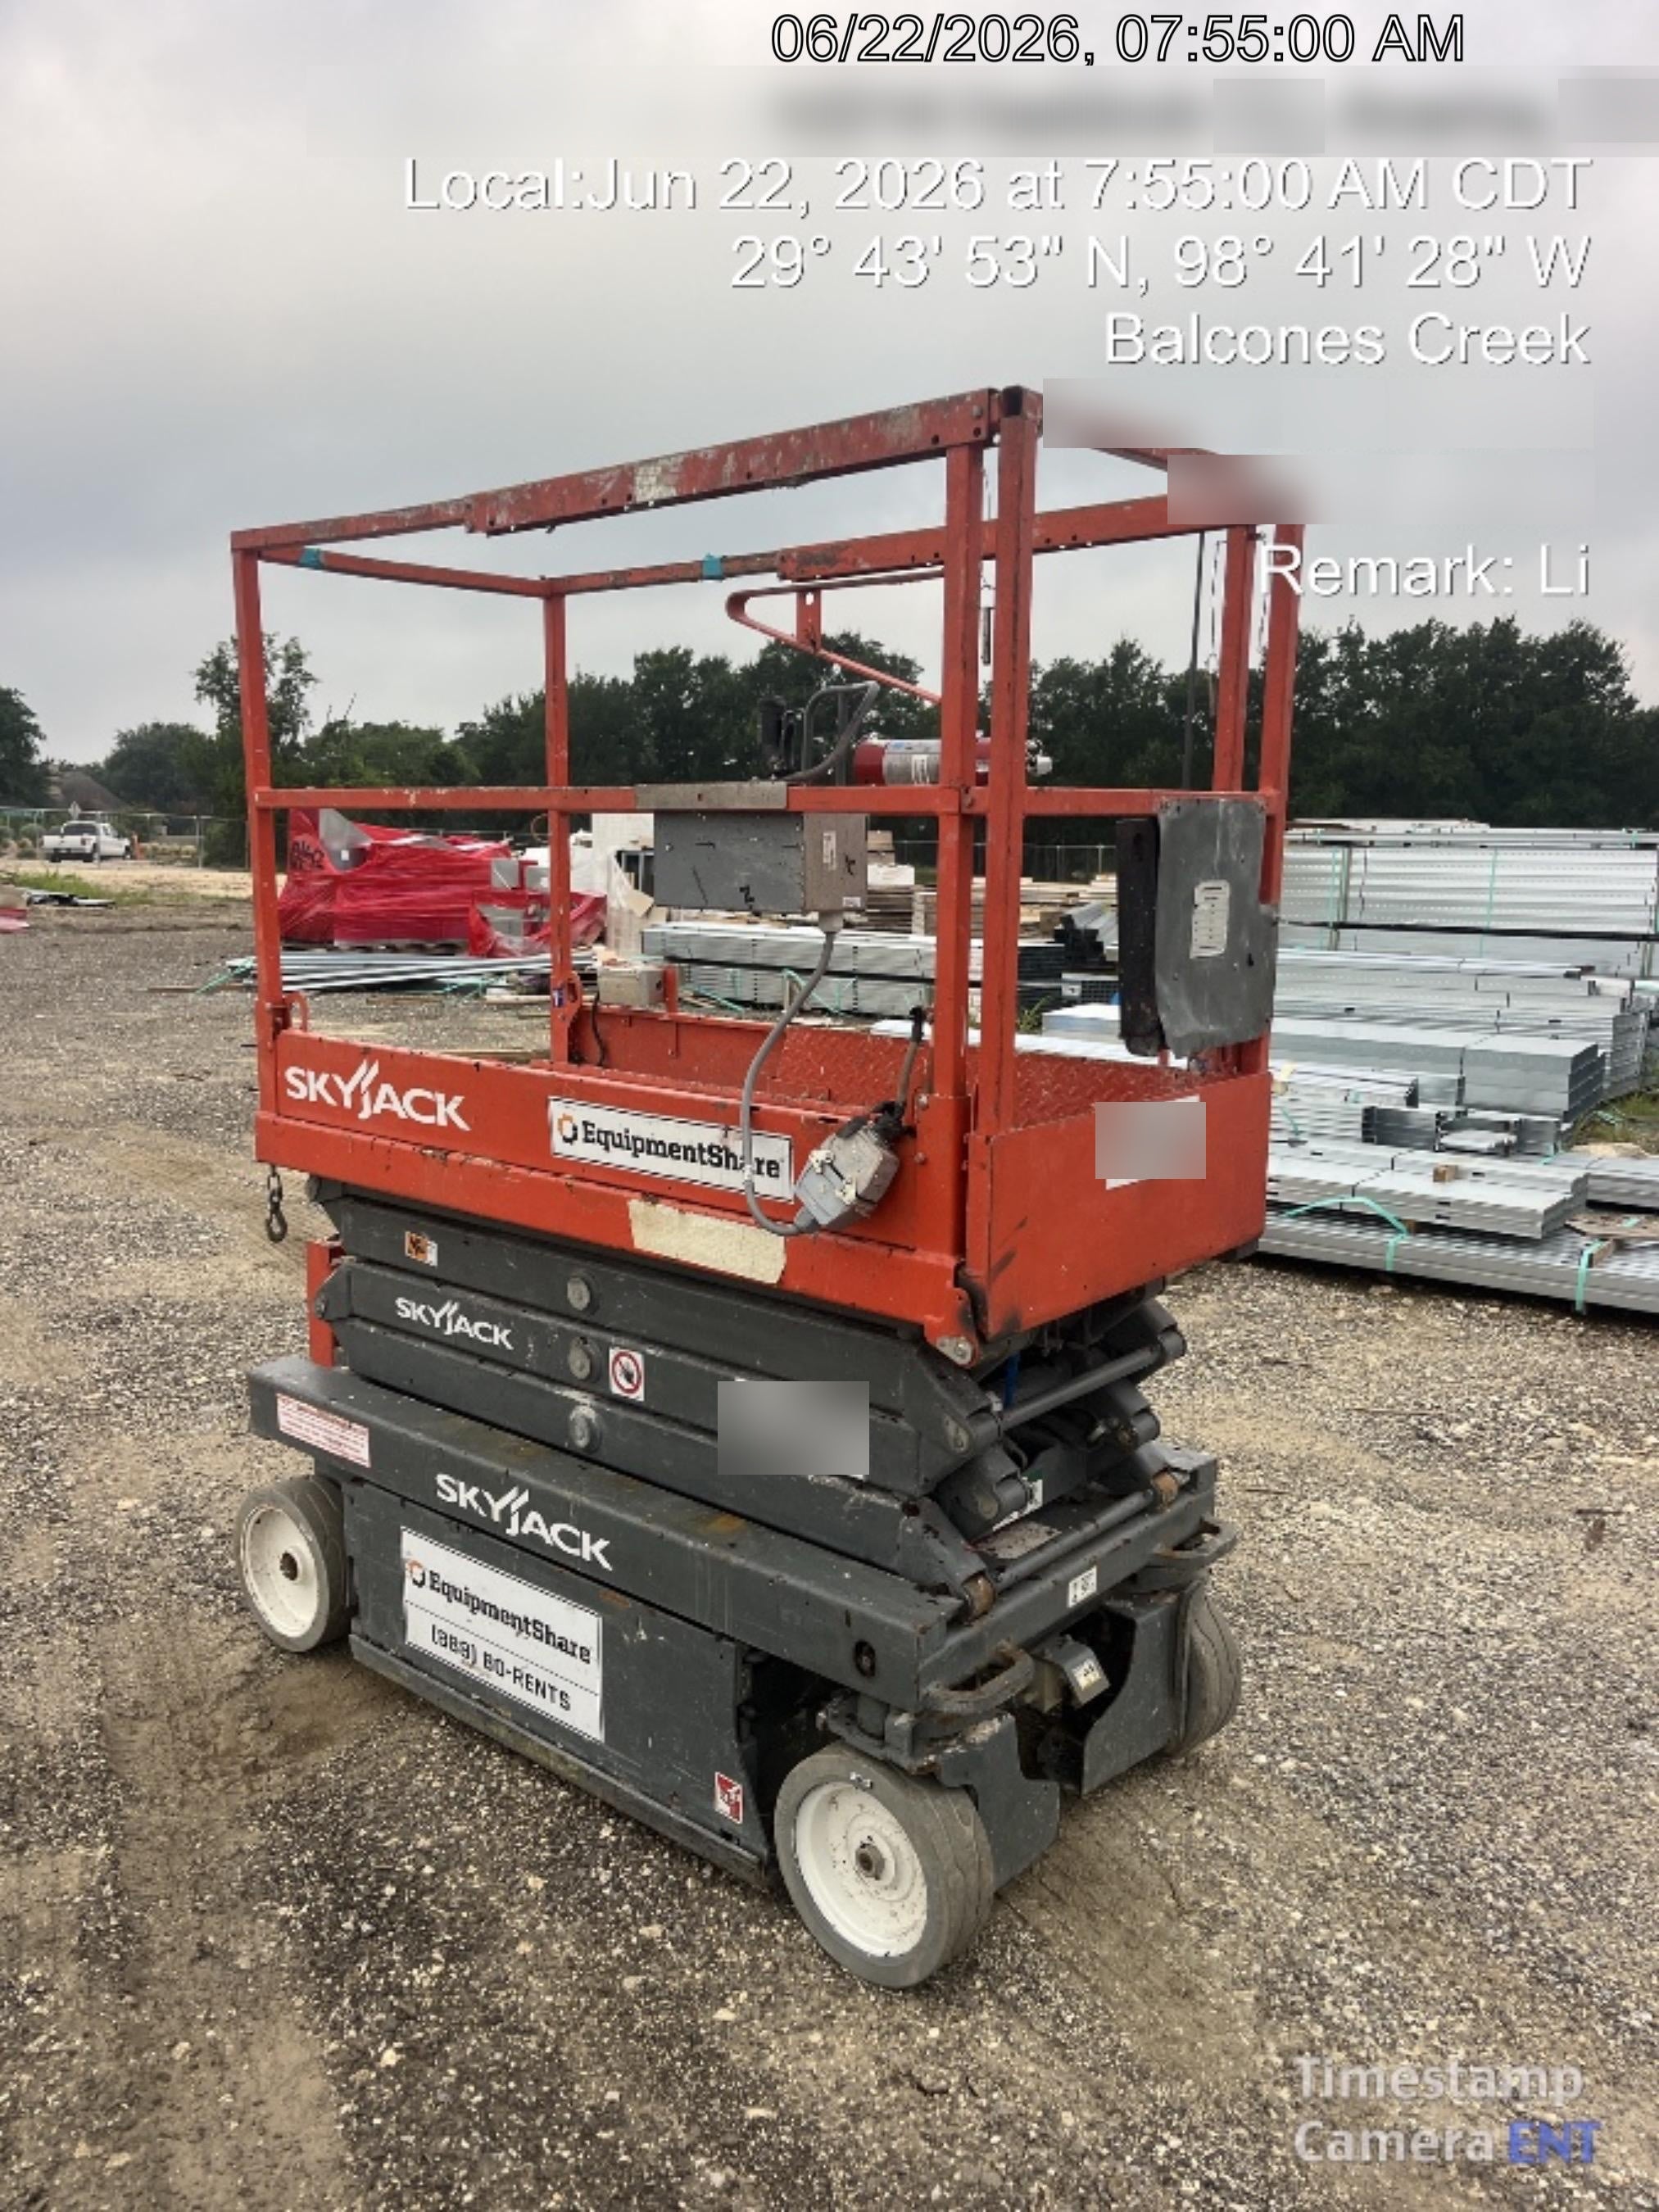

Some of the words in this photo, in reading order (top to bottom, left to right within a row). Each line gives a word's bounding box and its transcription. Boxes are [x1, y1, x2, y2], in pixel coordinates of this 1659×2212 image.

[284, 1060, 469, 1131] SKYJACK
[395, 1297, 514, 1350] SKYJACK
[435, 1472, 613, 1571] SKYJACK
[429, 1569, 592, 1666] EquipmentShare
